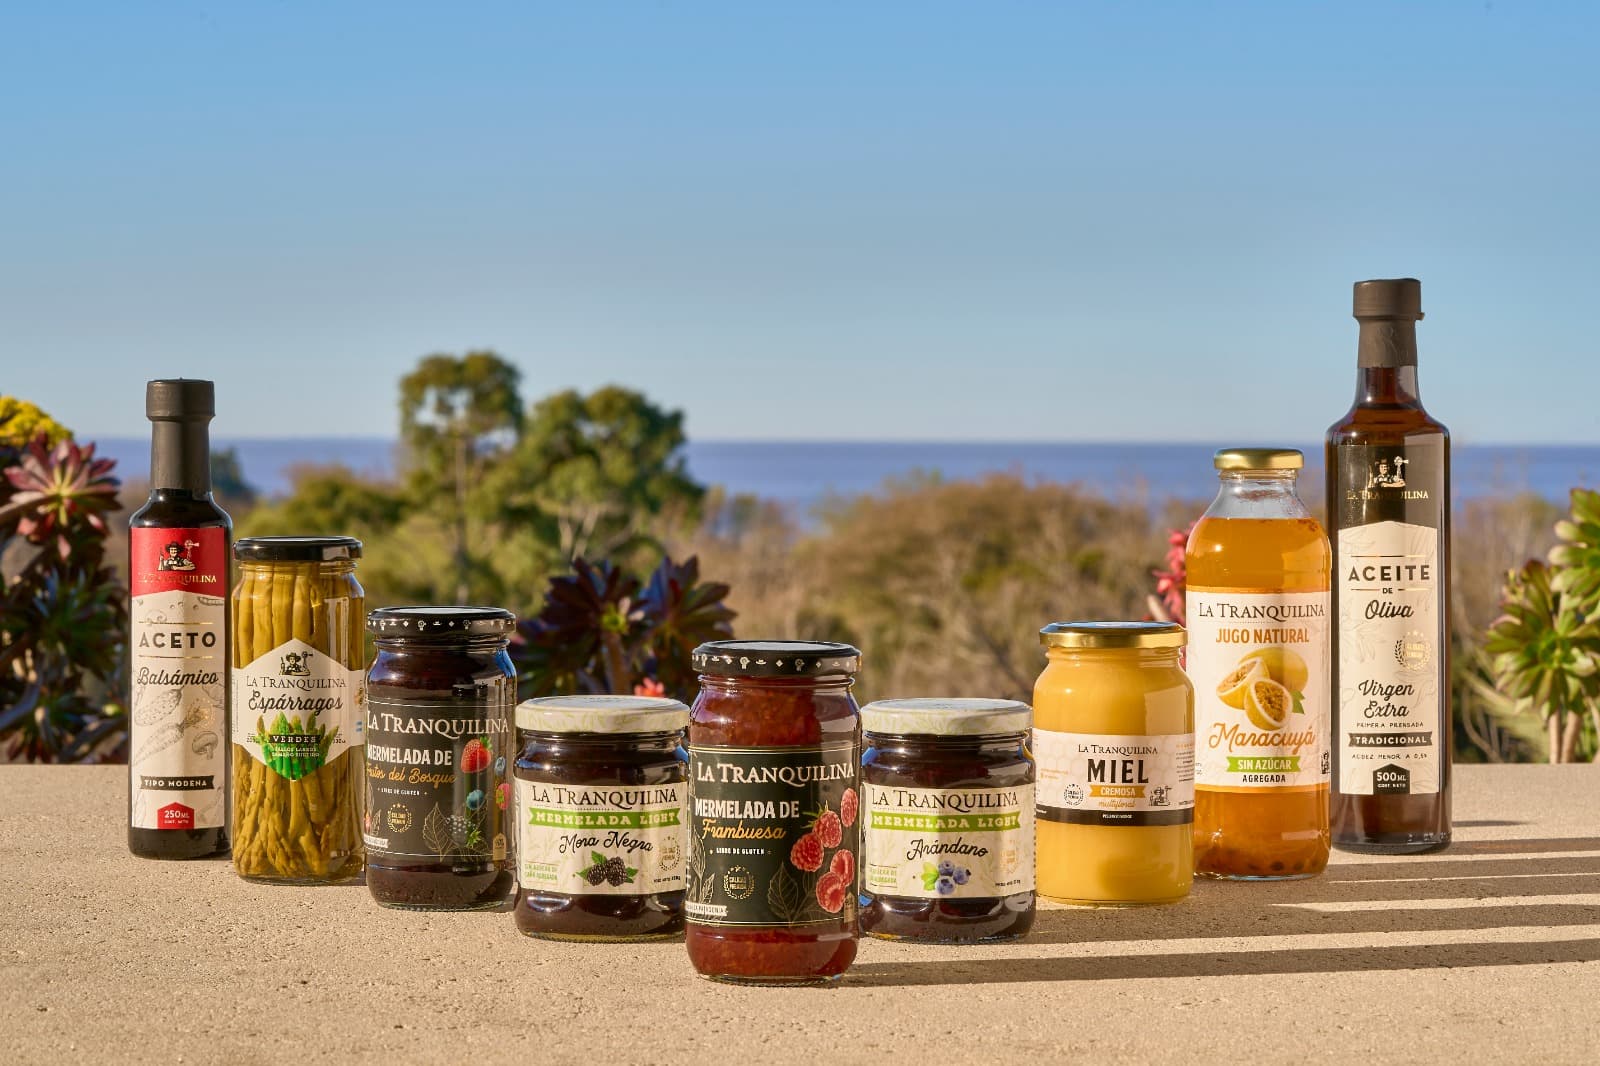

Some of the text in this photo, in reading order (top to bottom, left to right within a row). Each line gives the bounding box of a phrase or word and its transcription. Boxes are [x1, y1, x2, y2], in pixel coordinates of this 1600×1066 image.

[1348, 565, 1430, 581] ACEITE
[1199, 603, 1325, 622] LA TRANQUILINA
[1365, 599, 1414, 619] Oliva
[139, 632, 216, 648] ACETO
[1215, 628, 1309, 644] JUGO NATURAL
[137, 667, 218, 685] Balsámico
[246, 676, 347, 691] LA TRANQUILINA
[1358, 680, 1415, 701] Virgen
[248, 689, 343, 716] Espárragos
[1364, 700, 1409, 718] Extra
[367, 711, 509, 739] LA TRANQUILINA
[272, 735, 316, 743] VERDES
[1208, 723, 1316, 755] Maracuyá
[1356, 736, 1427, 744] TRADICIONAL
[368, 744, 453, 766] MERMELADA DE
[1078, 744, 1158, 756] LA TRANQUILINA
[1087, 758, 1149, 784] MIEL
[1238, 757, 1292, 770] SIN AZÚCAR
[144, 779, 207, 787] TIPO MODENA
[388, 765, 406, 781] del
[408, 768, 457, 789] Bosque
[697, 762, 855, 787] LA TRANQUILINA
[1242, 774, 1286, 783] AGREGADA
[532, 785, 677, 810] LA TRANQUILINA
[872, 788, 1018, 812] LA TRANQUILINA
[1100, 787, 1136, 796] CREMOSA
[695, 799, 800, 819] MERMELADA DE
[536, 812, 675, 826] MERMELADA LIGHT
[873, 815, 1017, 828] MERMELADA LIGHT
[702, 819, 786, 840] Frambuesa
[558, 833, 600, 854] Mora
[604, 831, 653, 854] Negra
[906, 837, 988, 861] Arándano
